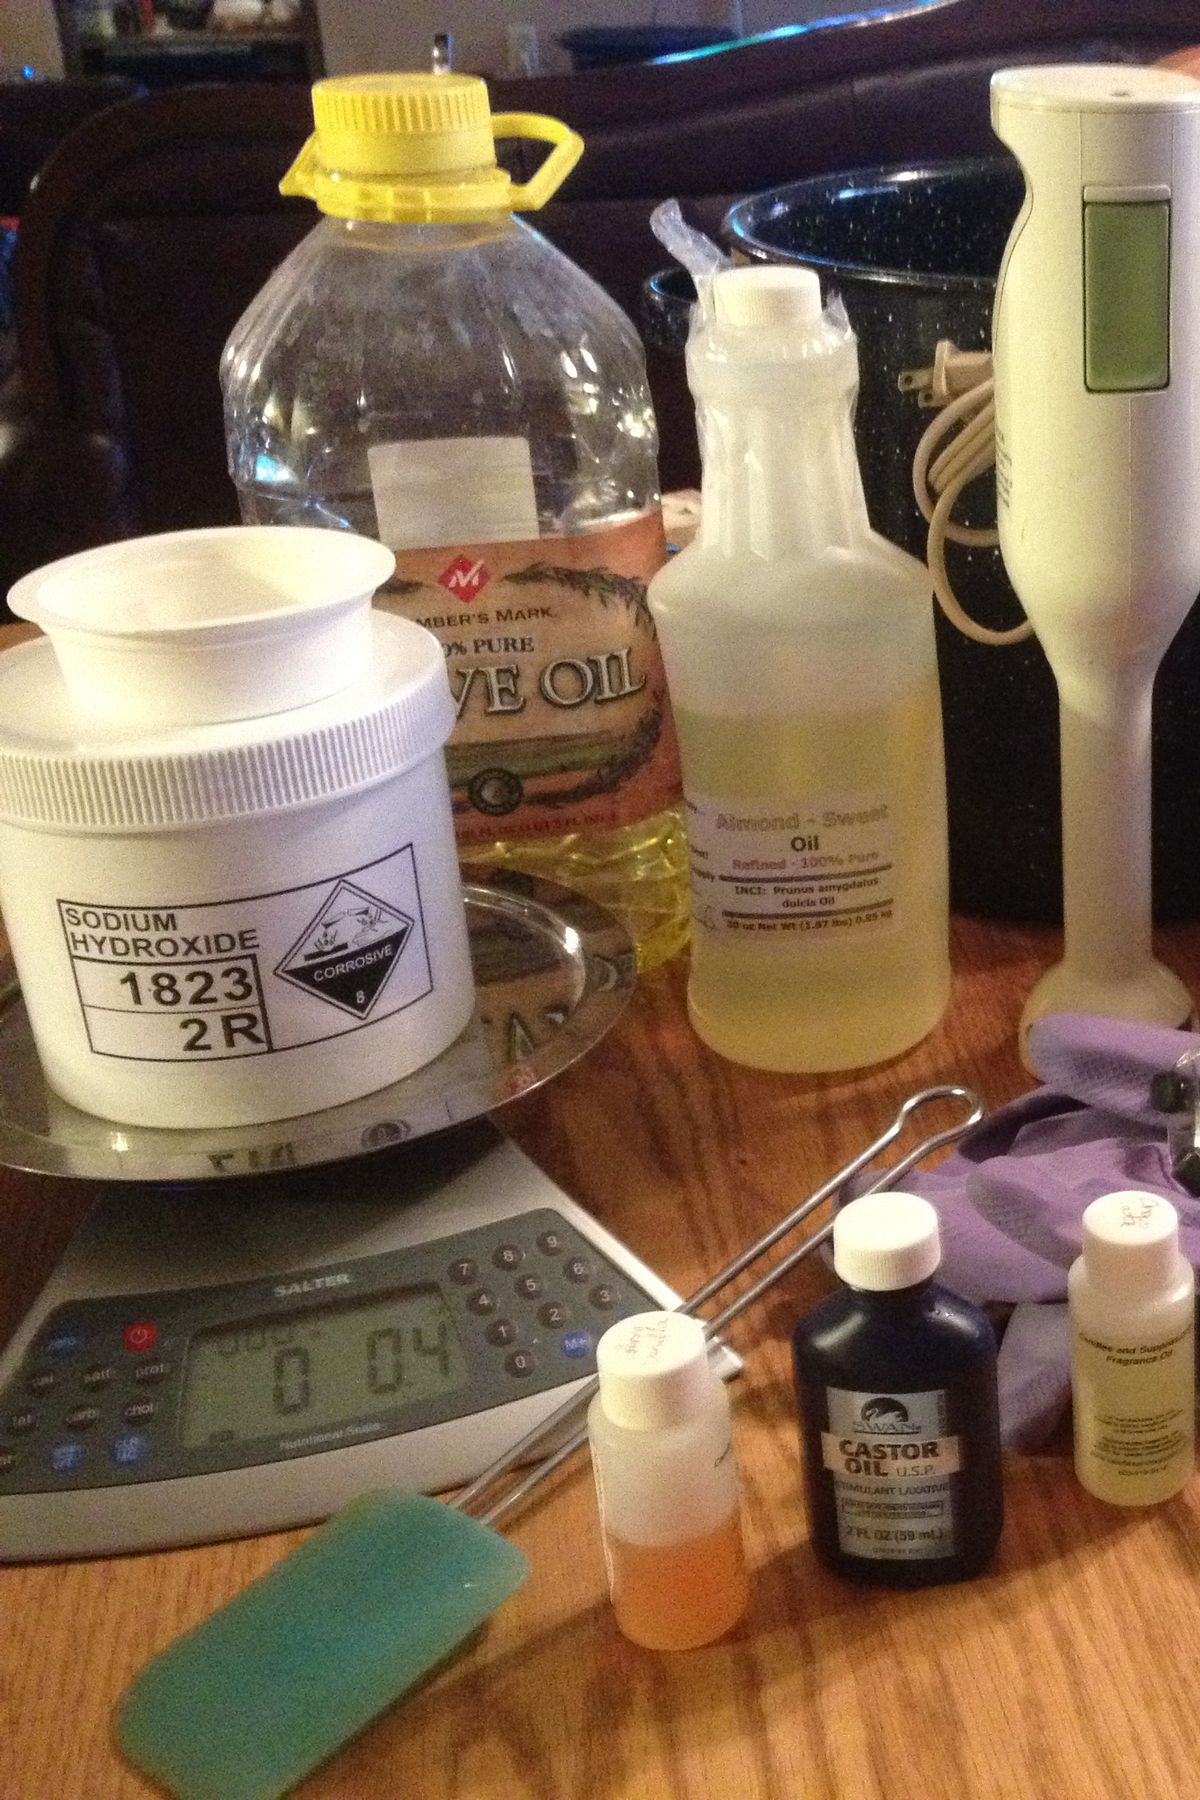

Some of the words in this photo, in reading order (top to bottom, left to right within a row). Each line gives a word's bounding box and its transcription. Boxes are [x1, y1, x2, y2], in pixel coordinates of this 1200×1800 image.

[415, 612, 489, 629] MBER'S
[496, 606, 552, 623] MARK
[445, 640, 467, 658] 0%
[473, 636, 535, 654] PURE
[540, 648, 647, 707] OIL
[790, 835, 820, 852] Oil
[65, 907, 178, 932] SODIUM
[70, 929, 260, 958] HYDROXIDE
[312, 944, 393, 982] CORROSIVE
[120, 966, 253, 1007] 1823
[356, 989, 366, 1004] 8
[547, 1236, 558, 1248] 9
[503, 1250, 513, 1262] 8
[459, 1263, 469, 1276] 7
[572, 1263, 584, 1275] 6
[274, 1273, 352, 1298] SALTER
[525, 1279, 537, 1291] 5
[479, 1293, 489, 1305] 4
[600, 1291, 610, 1303] 3
[550, 1308, 561, 1321] 2
[498, 1325, 507, 1338] 1
[515, 1355, 526, 1369] 0
[838, 1439, 940, 1461] CASTOR
[844, 1457, 889, 1478] OIL
[896, 1464, 937, 1478] U.S.P.
